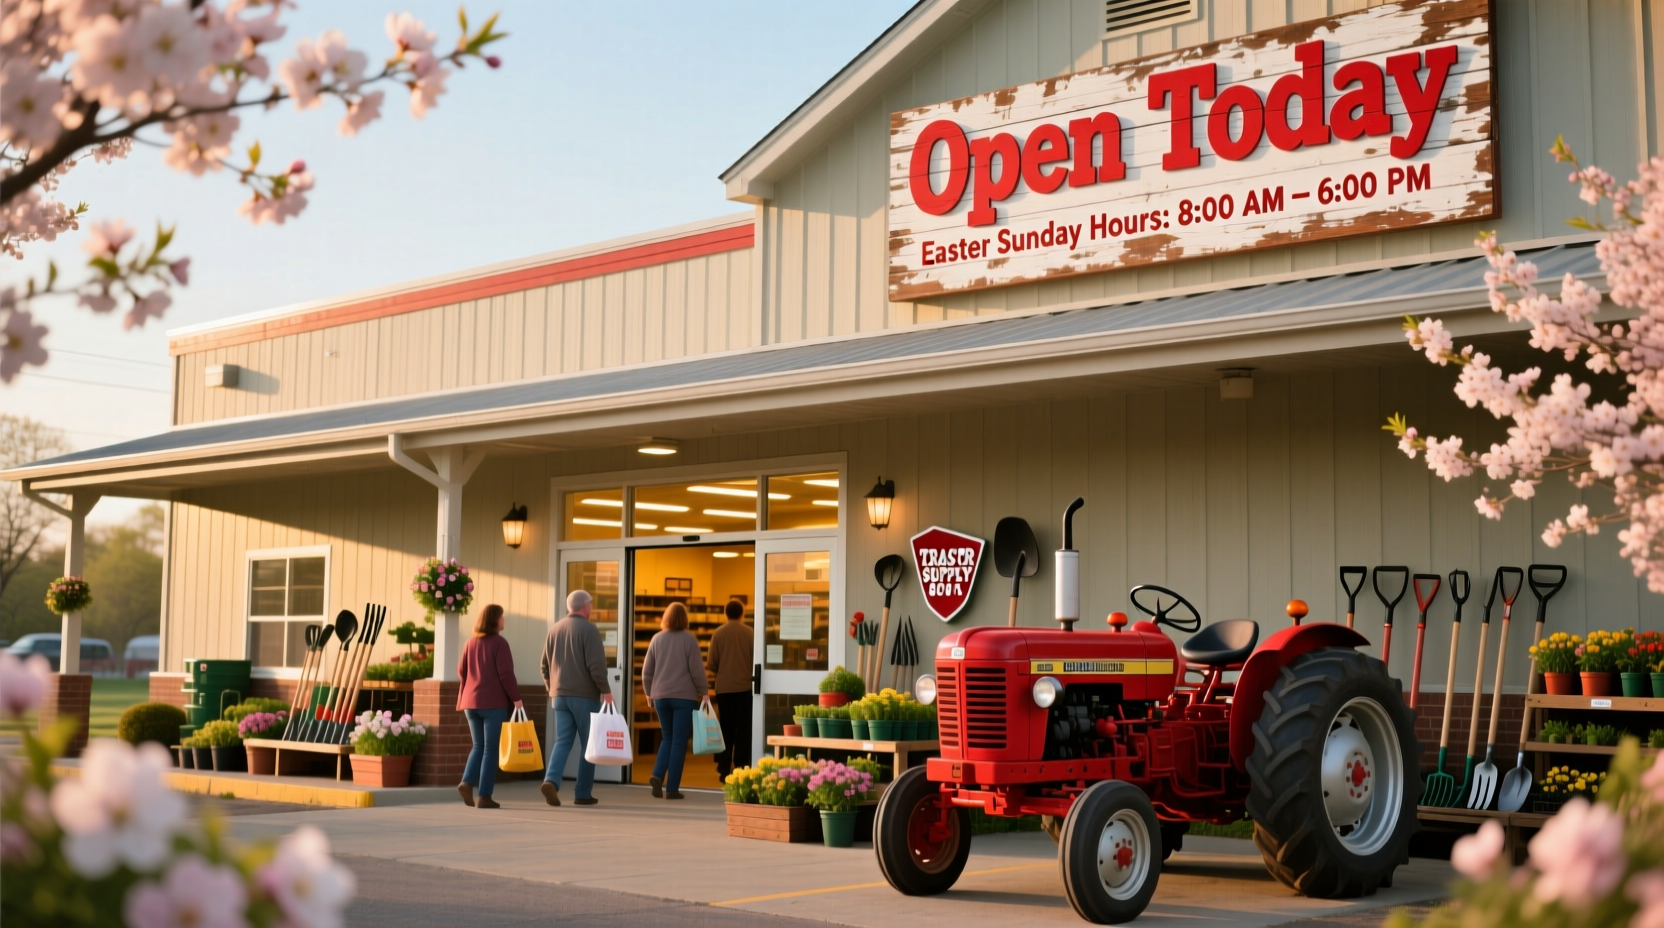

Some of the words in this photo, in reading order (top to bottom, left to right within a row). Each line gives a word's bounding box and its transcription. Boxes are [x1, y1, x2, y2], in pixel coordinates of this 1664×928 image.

[909, 112, 1126, 227] Open
[1148, 40, 1459, 171] Today
[921, 239, 990, 266] Easter
[997, 220, 1082, 251] Sunday
[1090, 209, 1170, 240] Hours:
[1178, 193, 1235, 226] 8:00
[1242, 186, 1285, 217] AM
[1317, 171, 1378, 205] 6:00
[1388, 163, 1431, 195] PM
[922, 566, 973, 583] SUPPLY
